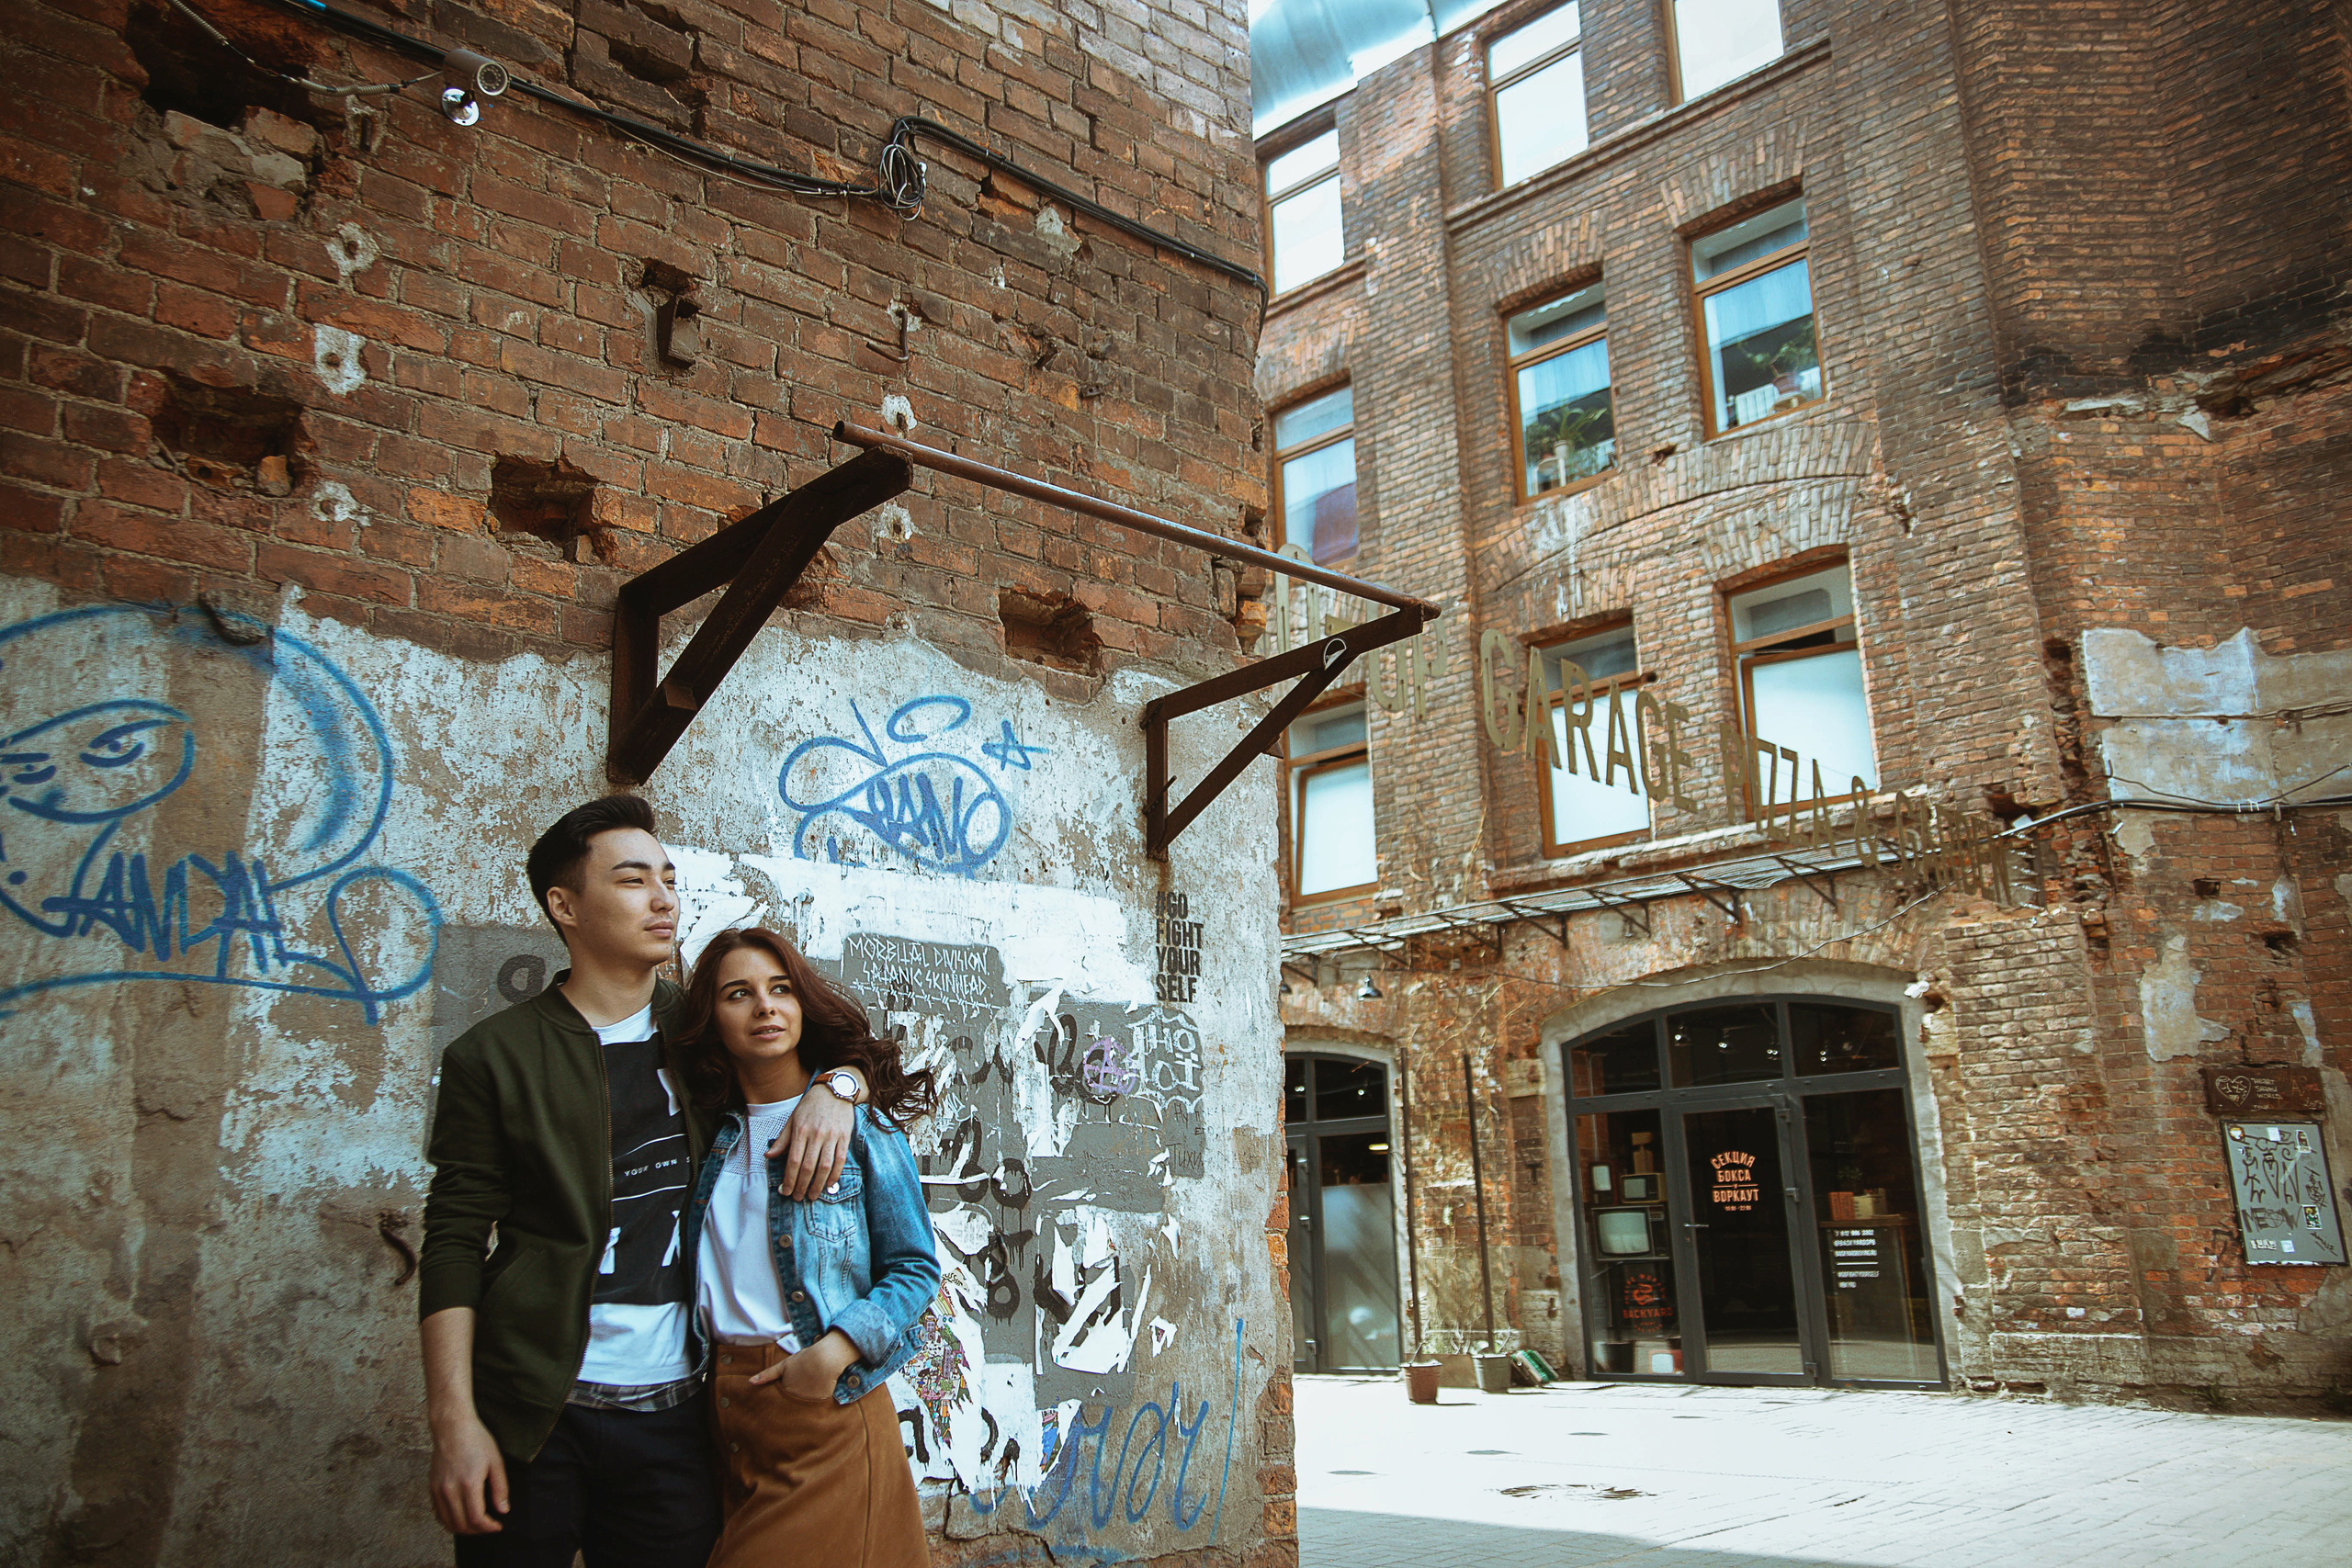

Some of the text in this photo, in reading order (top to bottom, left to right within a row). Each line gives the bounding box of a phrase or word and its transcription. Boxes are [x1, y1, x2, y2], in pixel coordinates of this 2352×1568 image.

[1480, 628, 1698, 814] GARAGE
[1720, 722, 1838, 857] PIZZA
[1156, 891, 1188, 919] #GO
[1156, 919, 1204, 949] FIGHT
[1156, 946, 1201, 976] YOUR
[1156, 974, 1197, 1003] SELF
[625, 1165, 650, 1177] YOUR
[655, 1158, 678, 1169] OWN
[1711, 1151, 1756, 1169] СЕКЦИЯ
[1716, 1168, 1752, 1183] БОКСА
[1713, 1189, 1759, 1203] ВОРКАУТ
[1623, 1307, 1674, 1319] BACKYARD
